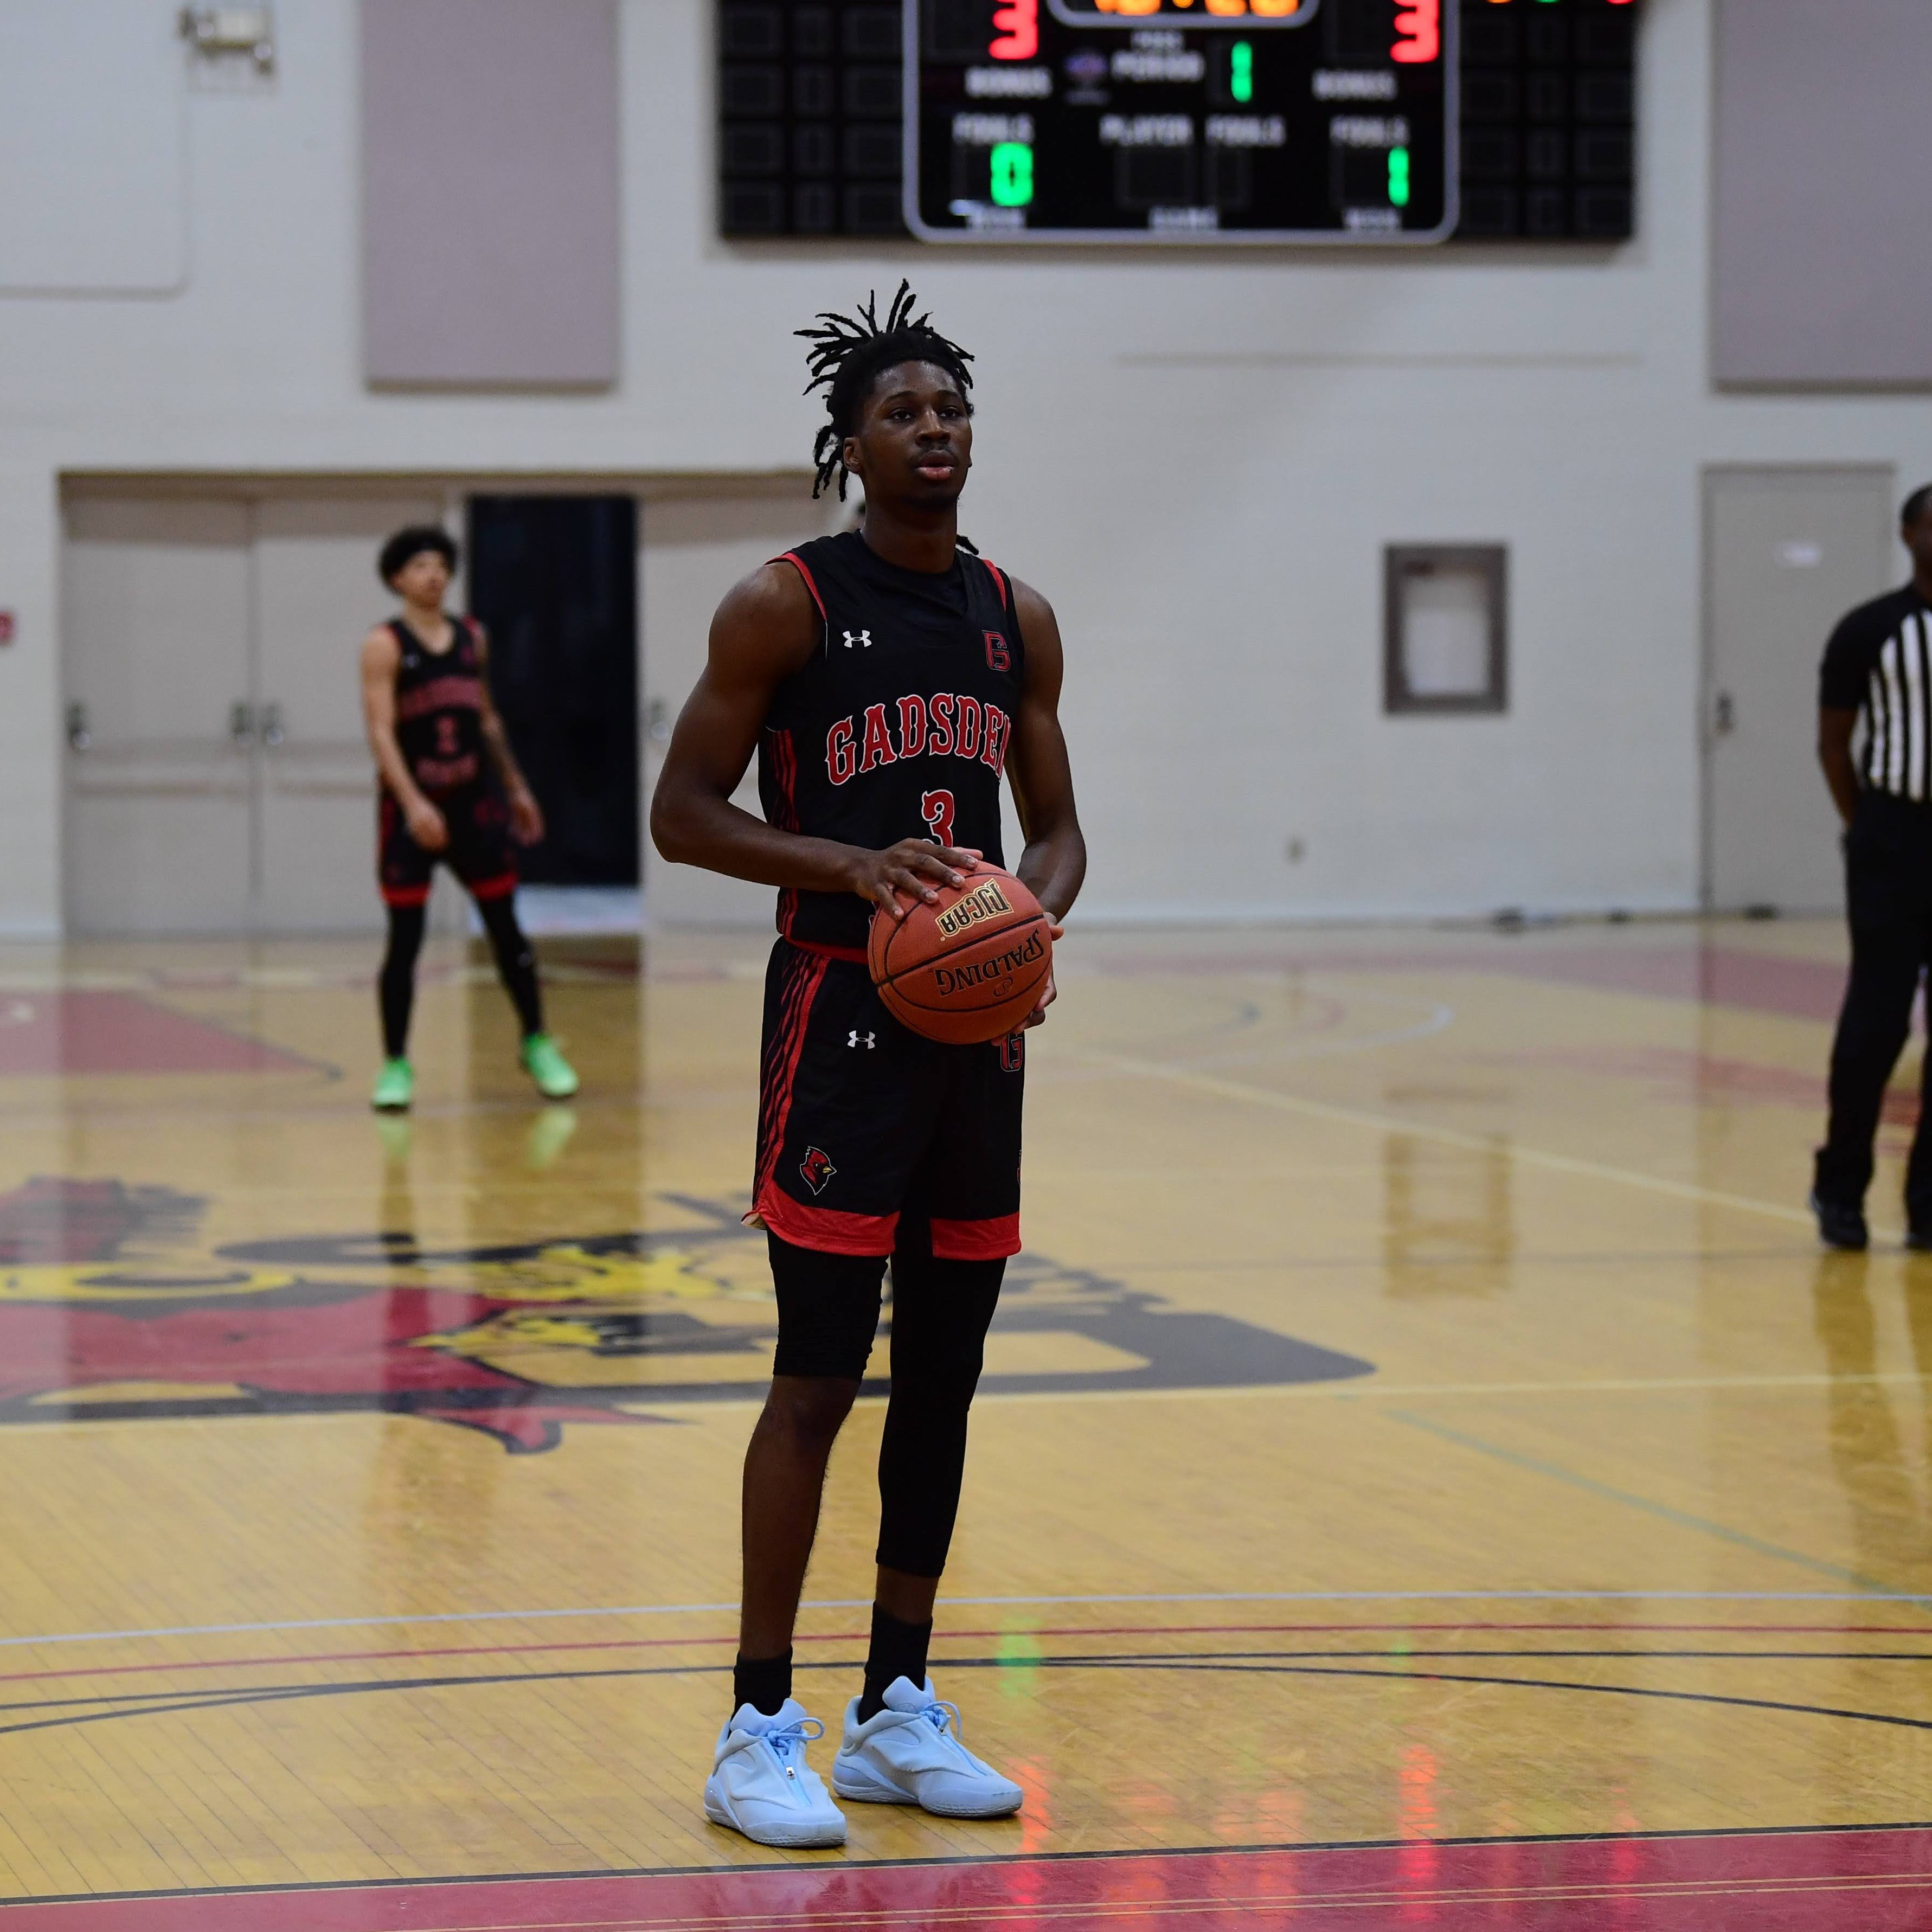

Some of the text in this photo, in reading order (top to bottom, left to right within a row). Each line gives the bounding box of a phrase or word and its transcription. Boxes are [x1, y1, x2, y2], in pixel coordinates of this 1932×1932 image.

[1231, 42, 1251, 102] 1
[1388, 146, 1408, 206] 1
[921, 790, 954, 848] 3
[935, 928, 1044, 996] SPALDING
